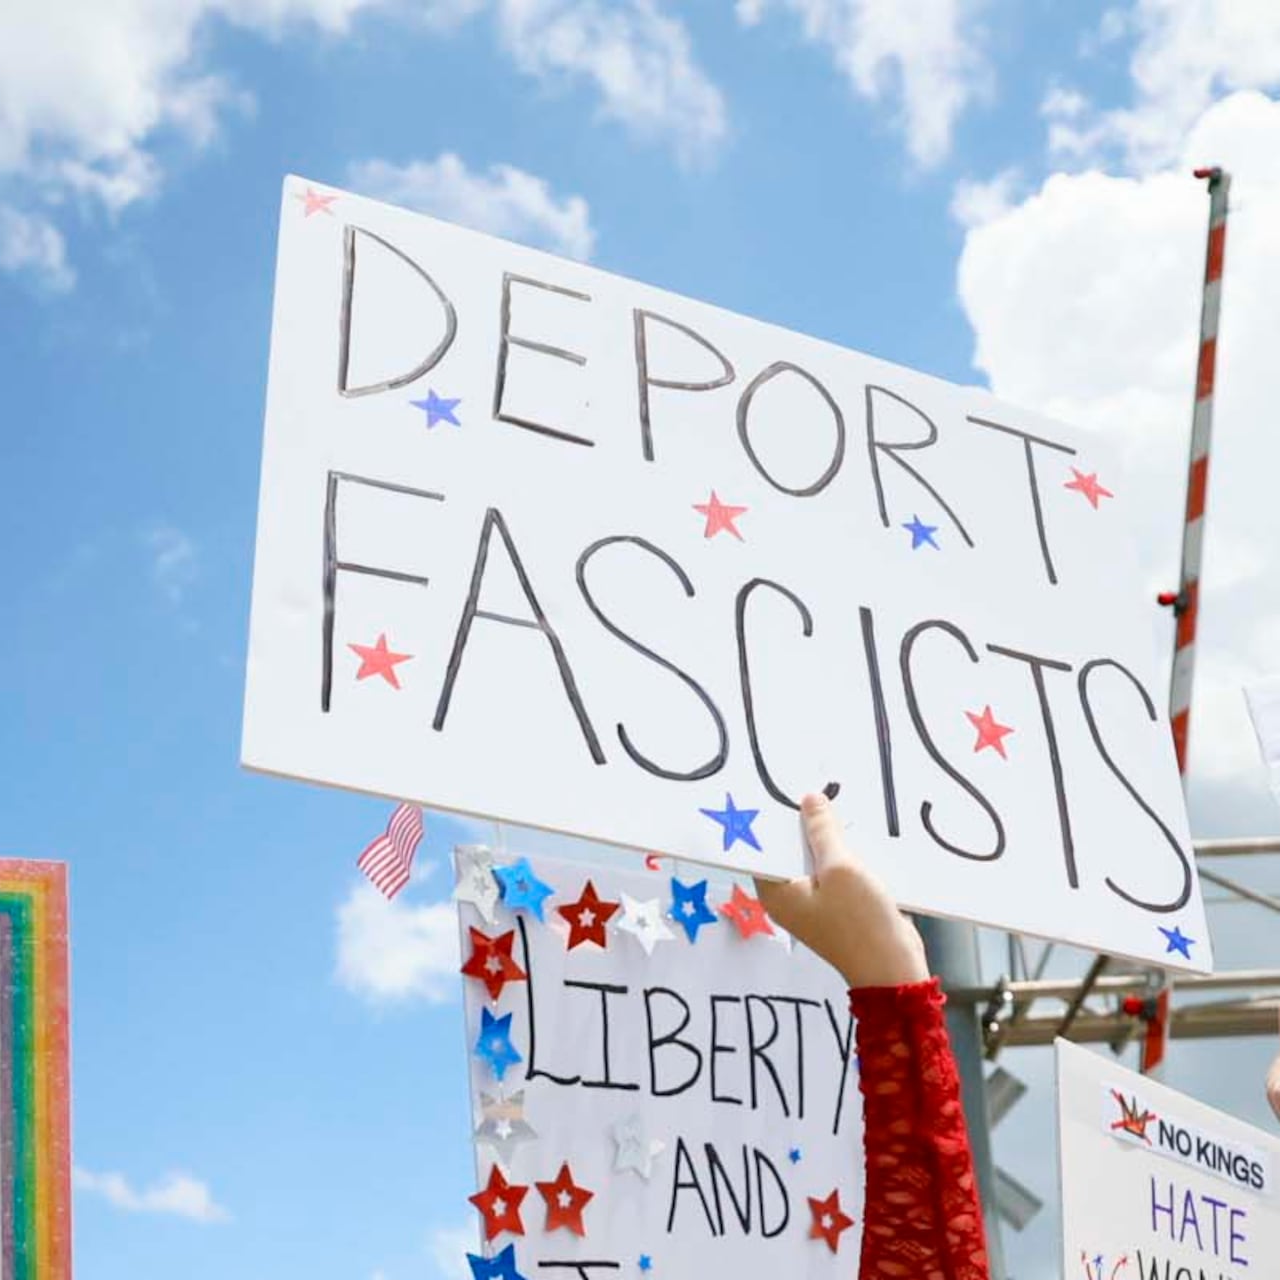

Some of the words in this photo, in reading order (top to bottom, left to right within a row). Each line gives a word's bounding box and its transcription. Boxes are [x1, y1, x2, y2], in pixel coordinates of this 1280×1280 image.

[337, 223, 1077, 585] DEPORT
[321, 470, 1192, 913] FASCISTS
[517, 914, 854, 1136] LIBERTY
[667, 1136, 790, 1238] AND
[1151, 1176, 1249, 1266] HATE
[1158, 1118, 1192, 1157] NO
[1195, 1141, 1264, 1190] KINGS
